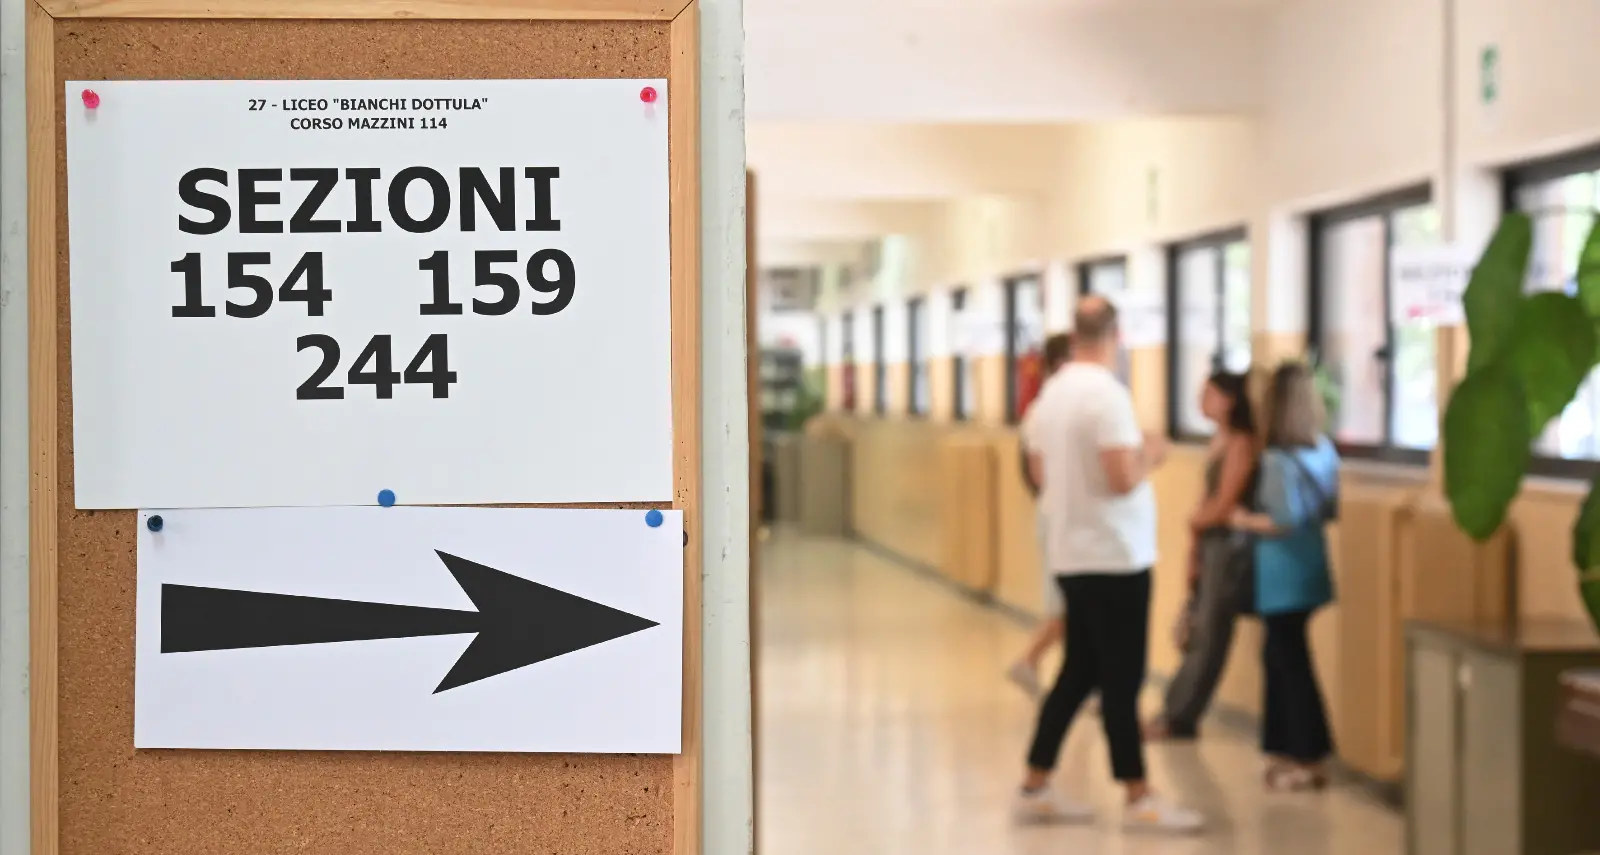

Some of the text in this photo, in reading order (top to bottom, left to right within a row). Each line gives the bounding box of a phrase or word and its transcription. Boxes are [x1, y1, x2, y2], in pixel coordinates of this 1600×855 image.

[248, 99, 267, 111] 27
[282, 98, 328, 111] LICEO
[332, 98, 407, 111] "BIANCHI
[411, 97, 489, 111] DOTTULA"
[290, 117, 448, 130] CORSO MAZZINI 114
[178, 166, 561, 235] SEZIONI
[170, 248, 576, 319] 154 159
[296, 333, 458, 400] 244
